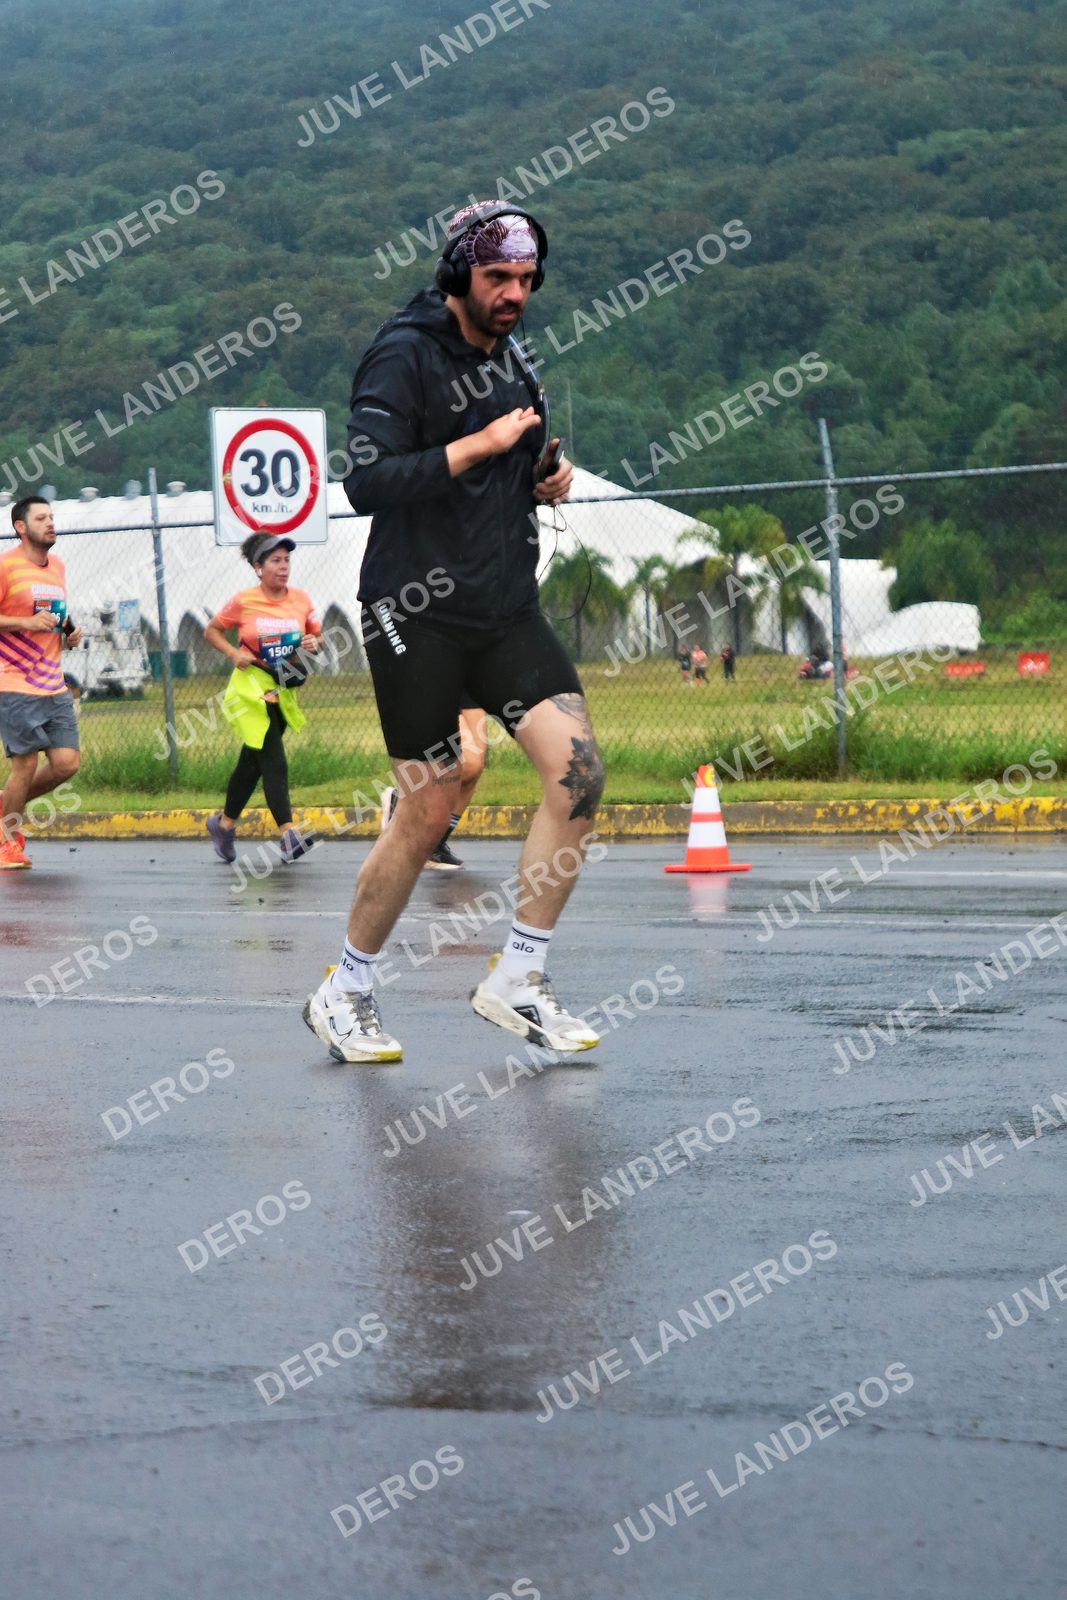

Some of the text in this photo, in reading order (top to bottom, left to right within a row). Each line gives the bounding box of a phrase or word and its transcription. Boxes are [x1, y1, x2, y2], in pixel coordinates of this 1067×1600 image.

[240, 448, 301, 497] 30
[377, 602, 407, 655] UNNING
[268, 644, 294, 658] 1500
[512, 940, 535, 954] alo
